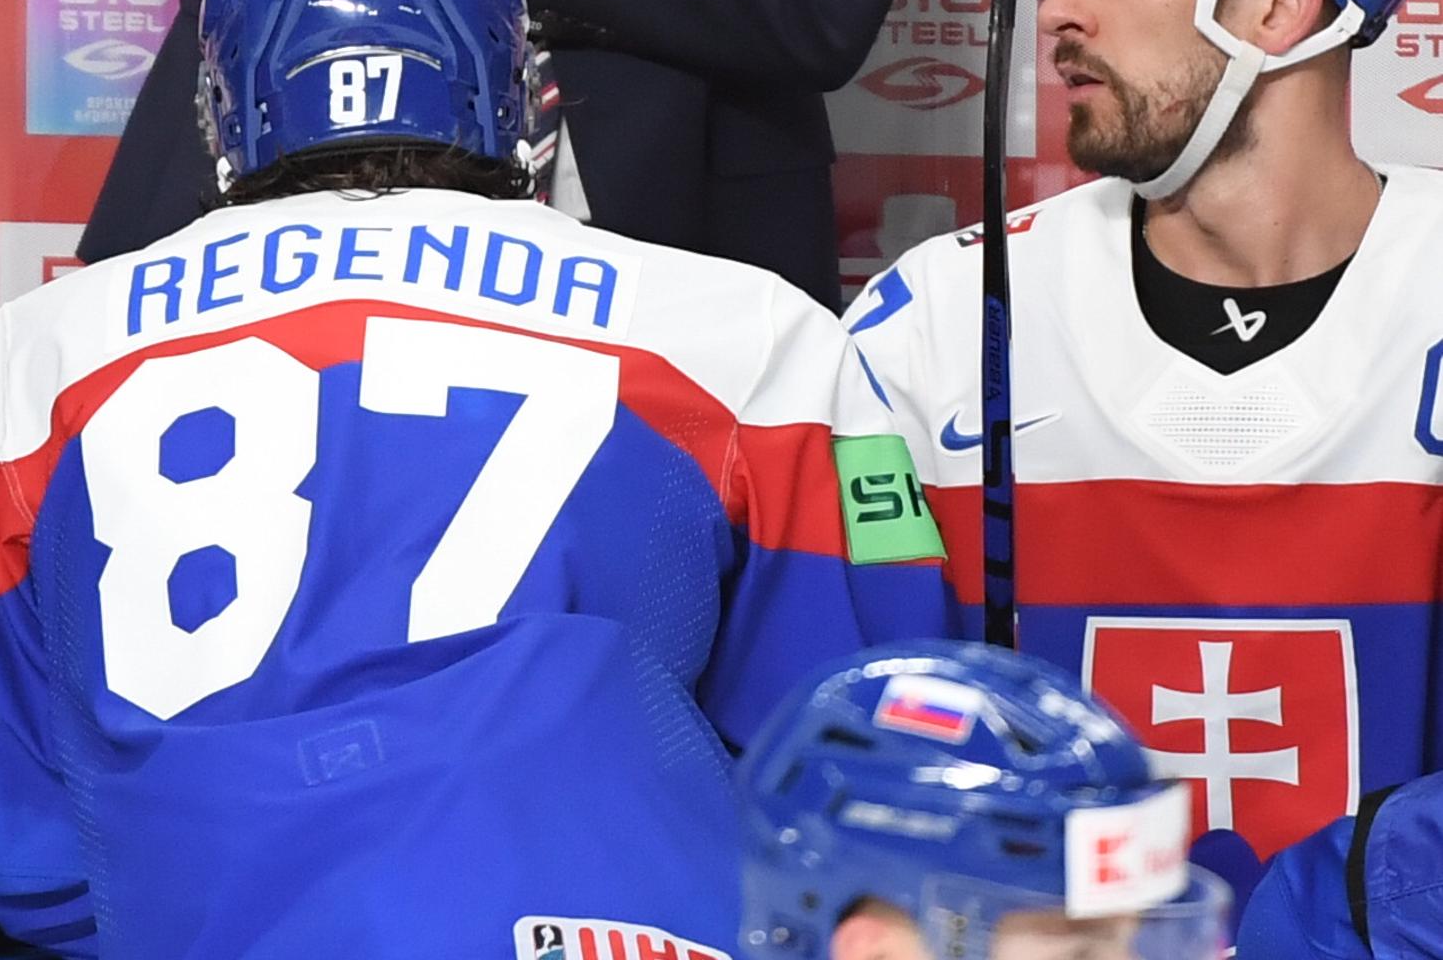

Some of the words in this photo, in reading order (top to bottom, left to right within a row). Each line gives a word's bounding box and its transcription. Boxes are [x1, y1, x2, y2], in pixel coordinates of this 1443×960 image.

[59, 10, 167, 31] STEEL
[886, 21, 989, 46] TEEL
[329, 54, 403, 125] 87
[127, 224, 618, 337] REGENDA
[80, 315, 621, 721] 87
